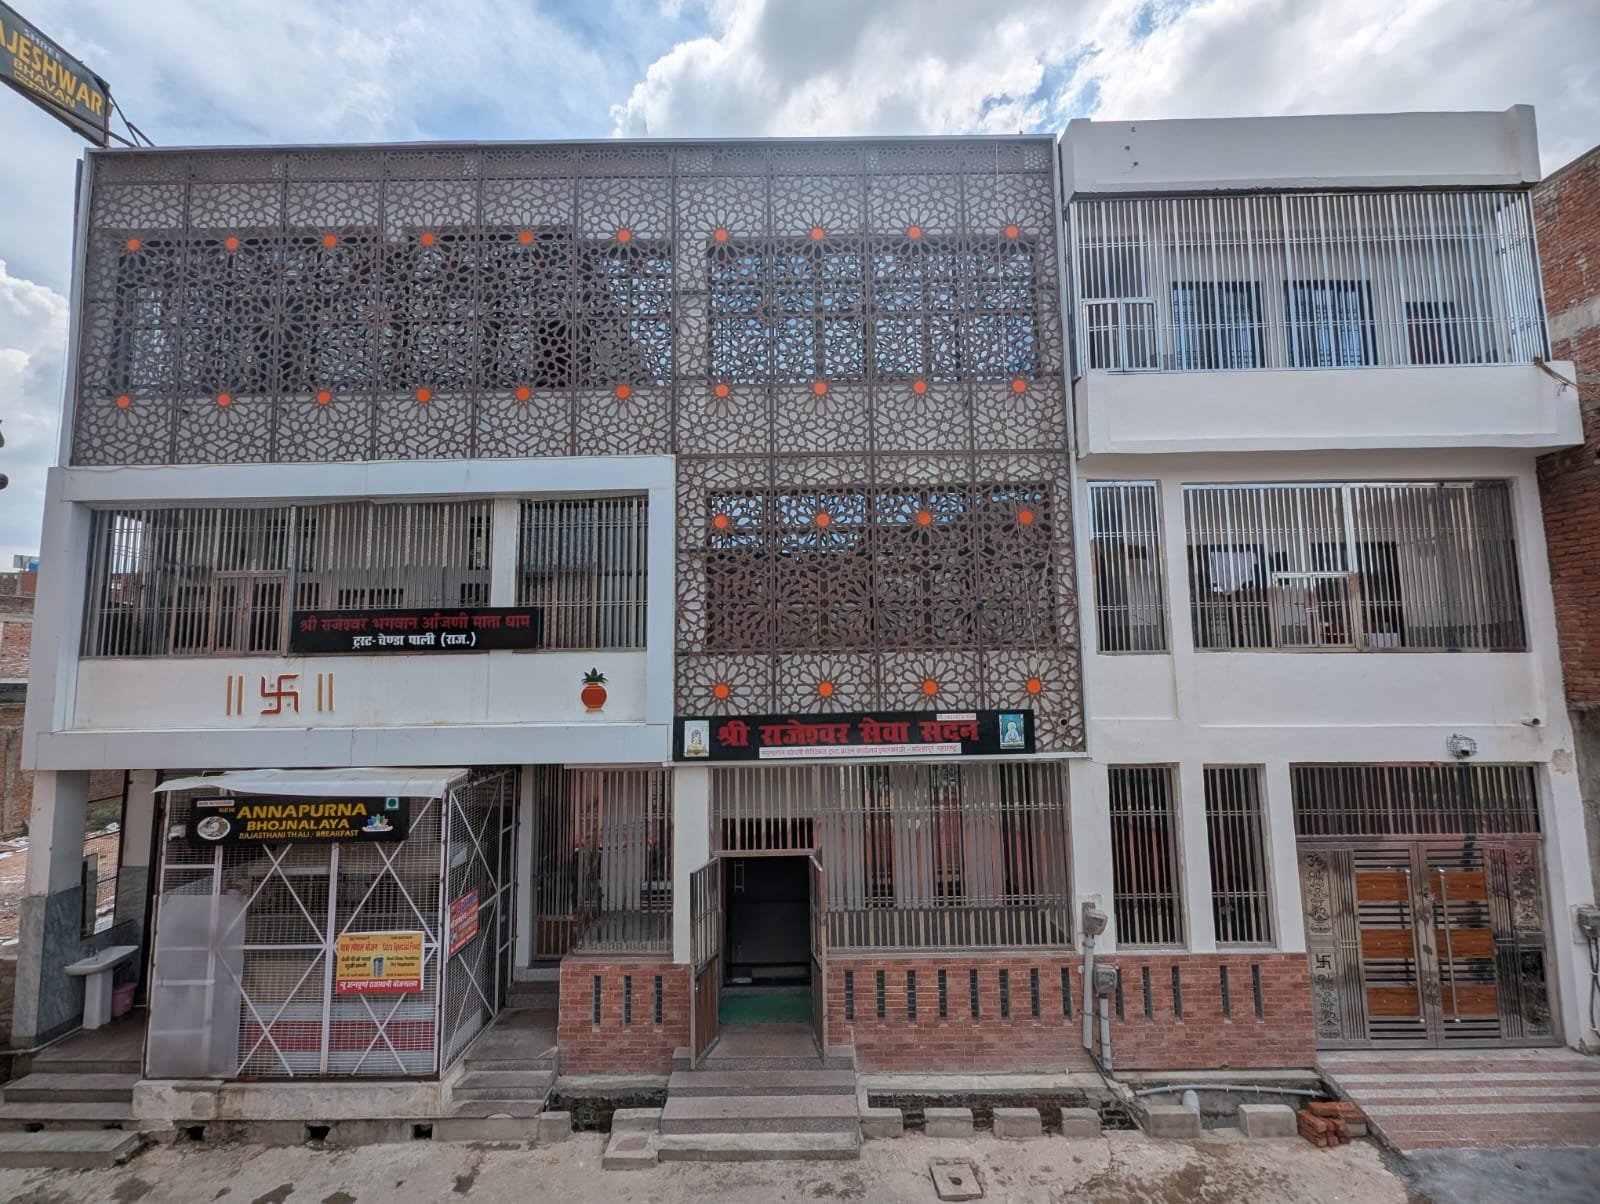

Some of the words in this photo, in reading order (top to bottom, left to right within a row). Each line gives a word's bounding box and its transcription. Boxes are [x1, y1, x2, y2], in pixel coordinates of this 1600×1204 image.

[13, 58, 76, 108] BHAVAN
[299, 614, 318, 631] श्री
[372, 616, 418, 631] भगवान
[471, 615, 502, 629] माता
[505, 614, 532, 628] धाम
[408, 632, 436, 646] पाली
[440, 631, 477, 647] (राज.)
[717, 719, 751, 747] श्री
[758, 719, 851, 746] राजेश्वर
[858, 716, 911, 743] सेवा
[919, 719, 980, 742] सदन
[236, 803, 367, 819] ANNAPURNA
[246, 818, 350, 831] BHOJNALAYA
[239, 832, 286, 840] RAJASTHANI
[316, 829, 359, 838] BREAKFAST
